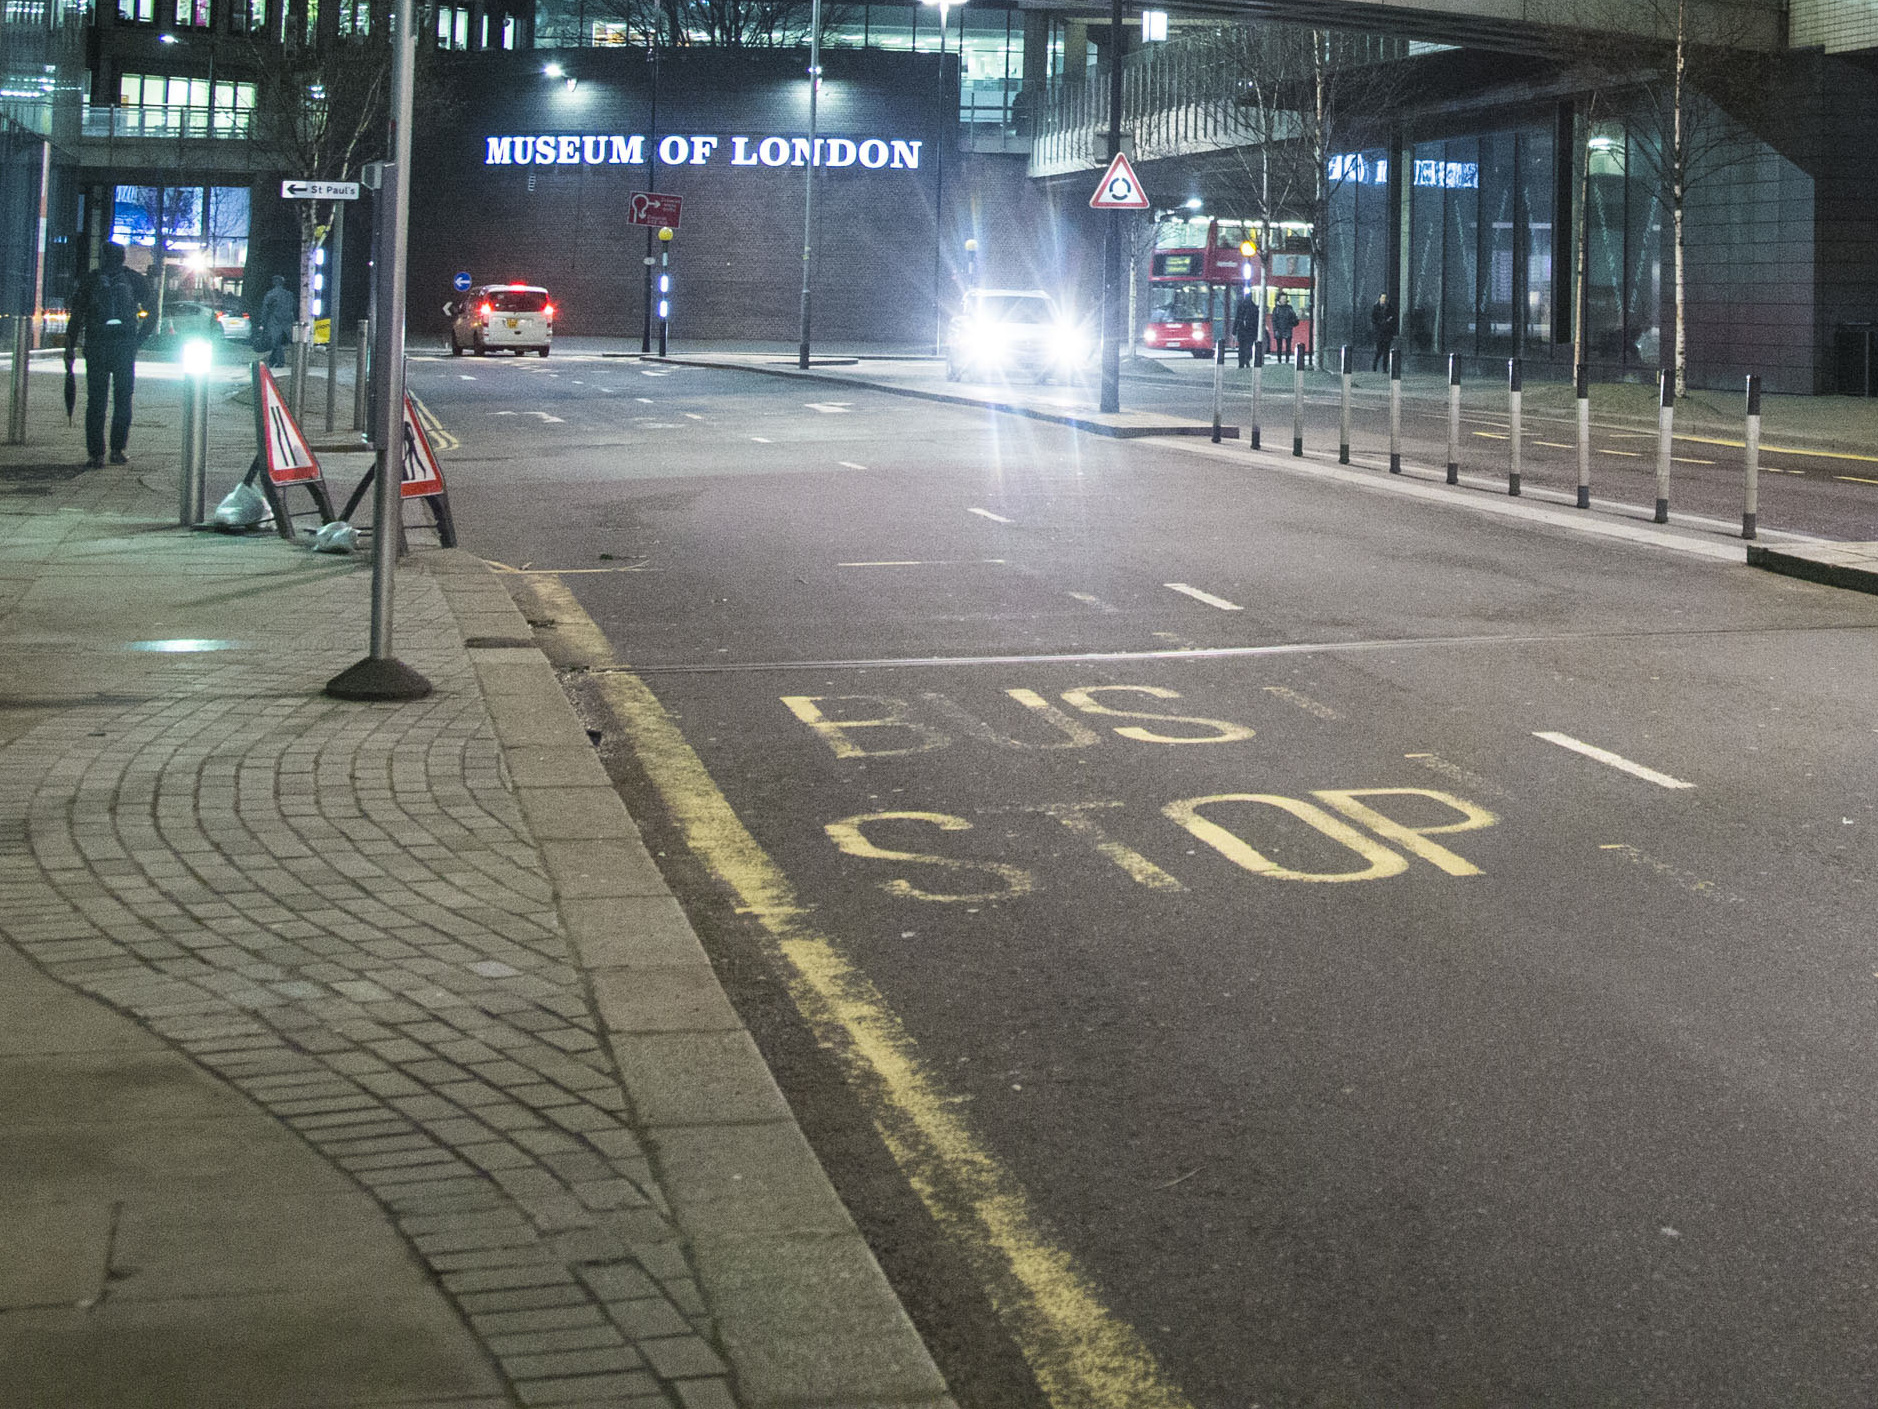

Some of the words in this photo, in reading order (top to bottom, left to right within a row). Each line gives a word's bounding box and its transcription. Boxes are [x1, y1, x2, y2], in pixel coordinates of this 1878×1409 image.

[484, 134, 644, 165] MUSEUM
[658, 135, 718, 166] OF
[730, 136, 923, 170] LONDON
[311, 185, 322, 194] St
[326, 185, 355, 195] Paul's
[779, 685, 1257, 760] BUS
[823, 788, 1500, 903] STOP
